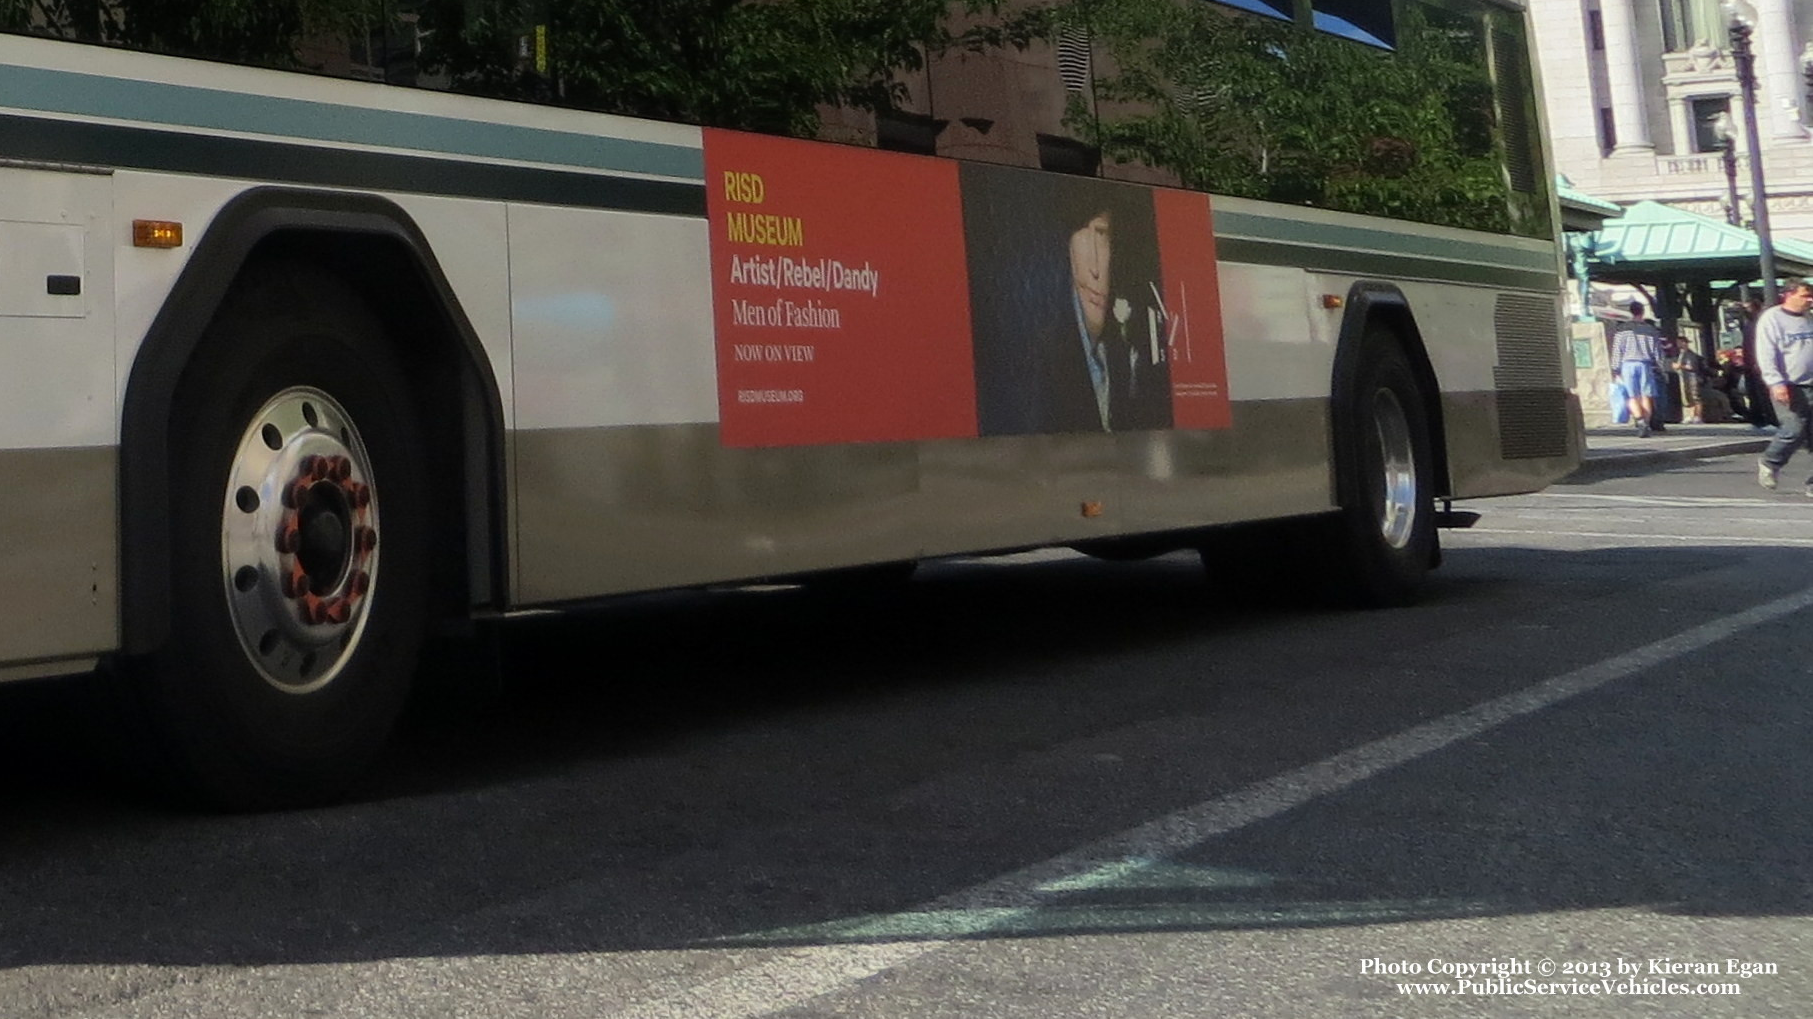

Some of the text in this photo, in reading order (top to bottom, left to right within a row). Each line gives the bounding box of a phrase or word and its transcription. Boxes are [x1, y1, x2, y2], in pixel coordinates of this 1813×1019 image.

[724, 170, 765, 204] RISD
[727, 212, 804, 247] MUSEUM
[730, 253, 879, 298] Artist/Rebel/Dandy
[731, 297, 841, 329] Men of Fashion
[733, 343, 815, 362] NOW ON VIEW
